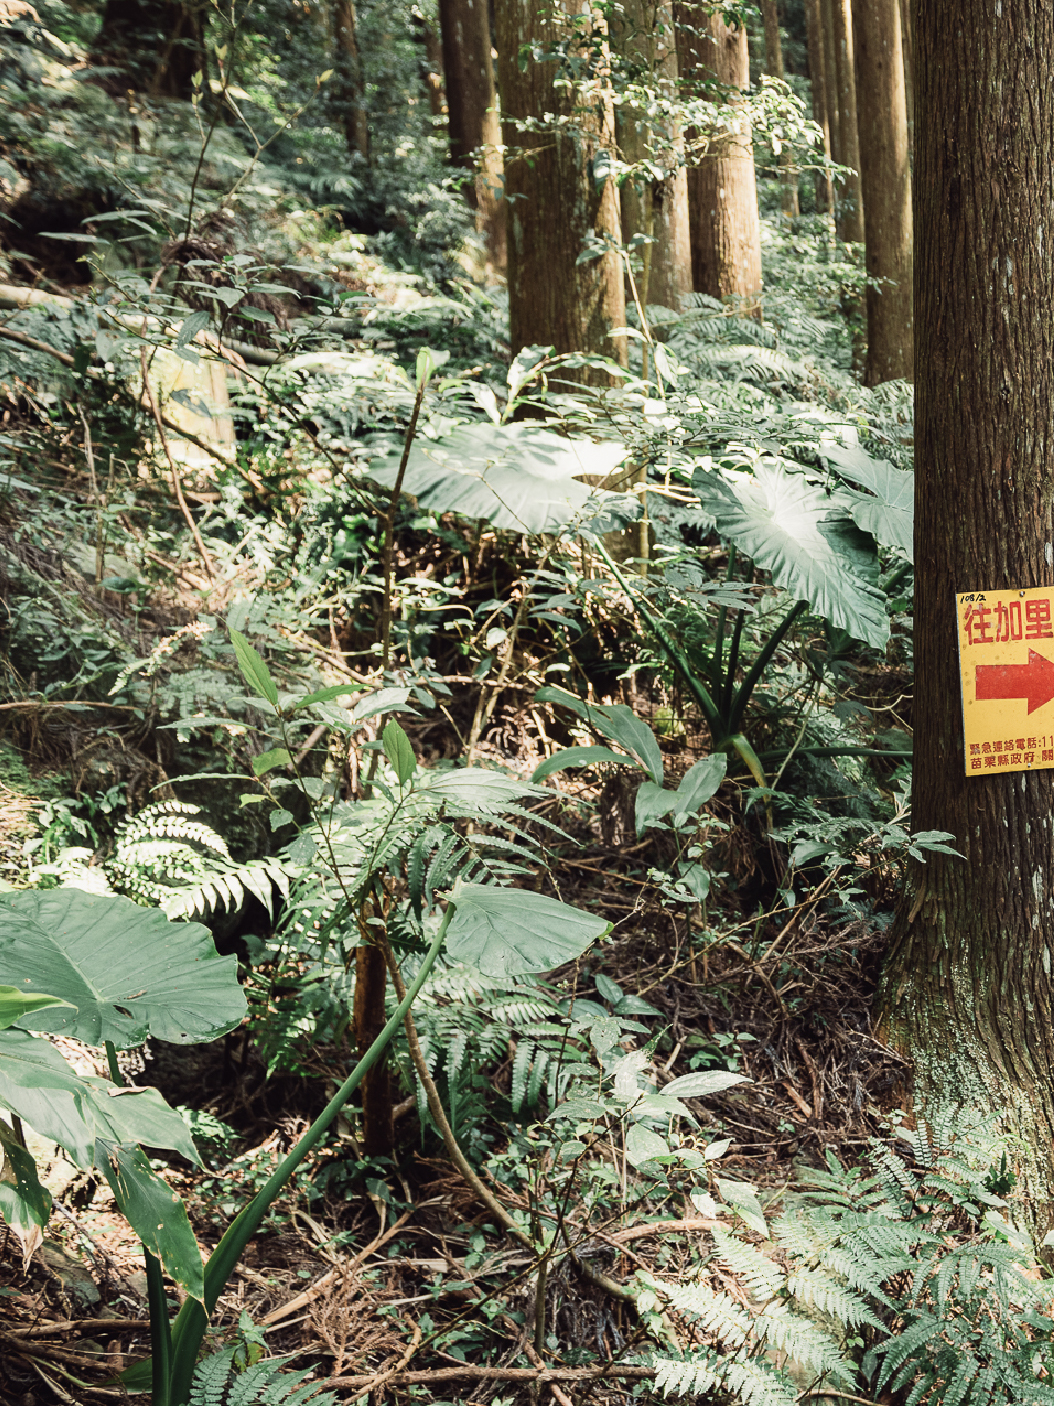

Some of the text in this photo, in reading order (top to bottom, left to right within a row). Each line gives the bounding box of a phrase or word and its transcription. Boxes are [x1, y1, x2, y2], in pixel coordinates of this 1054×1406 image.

[970, 751, 1035, 769] 苗栗縣政府
